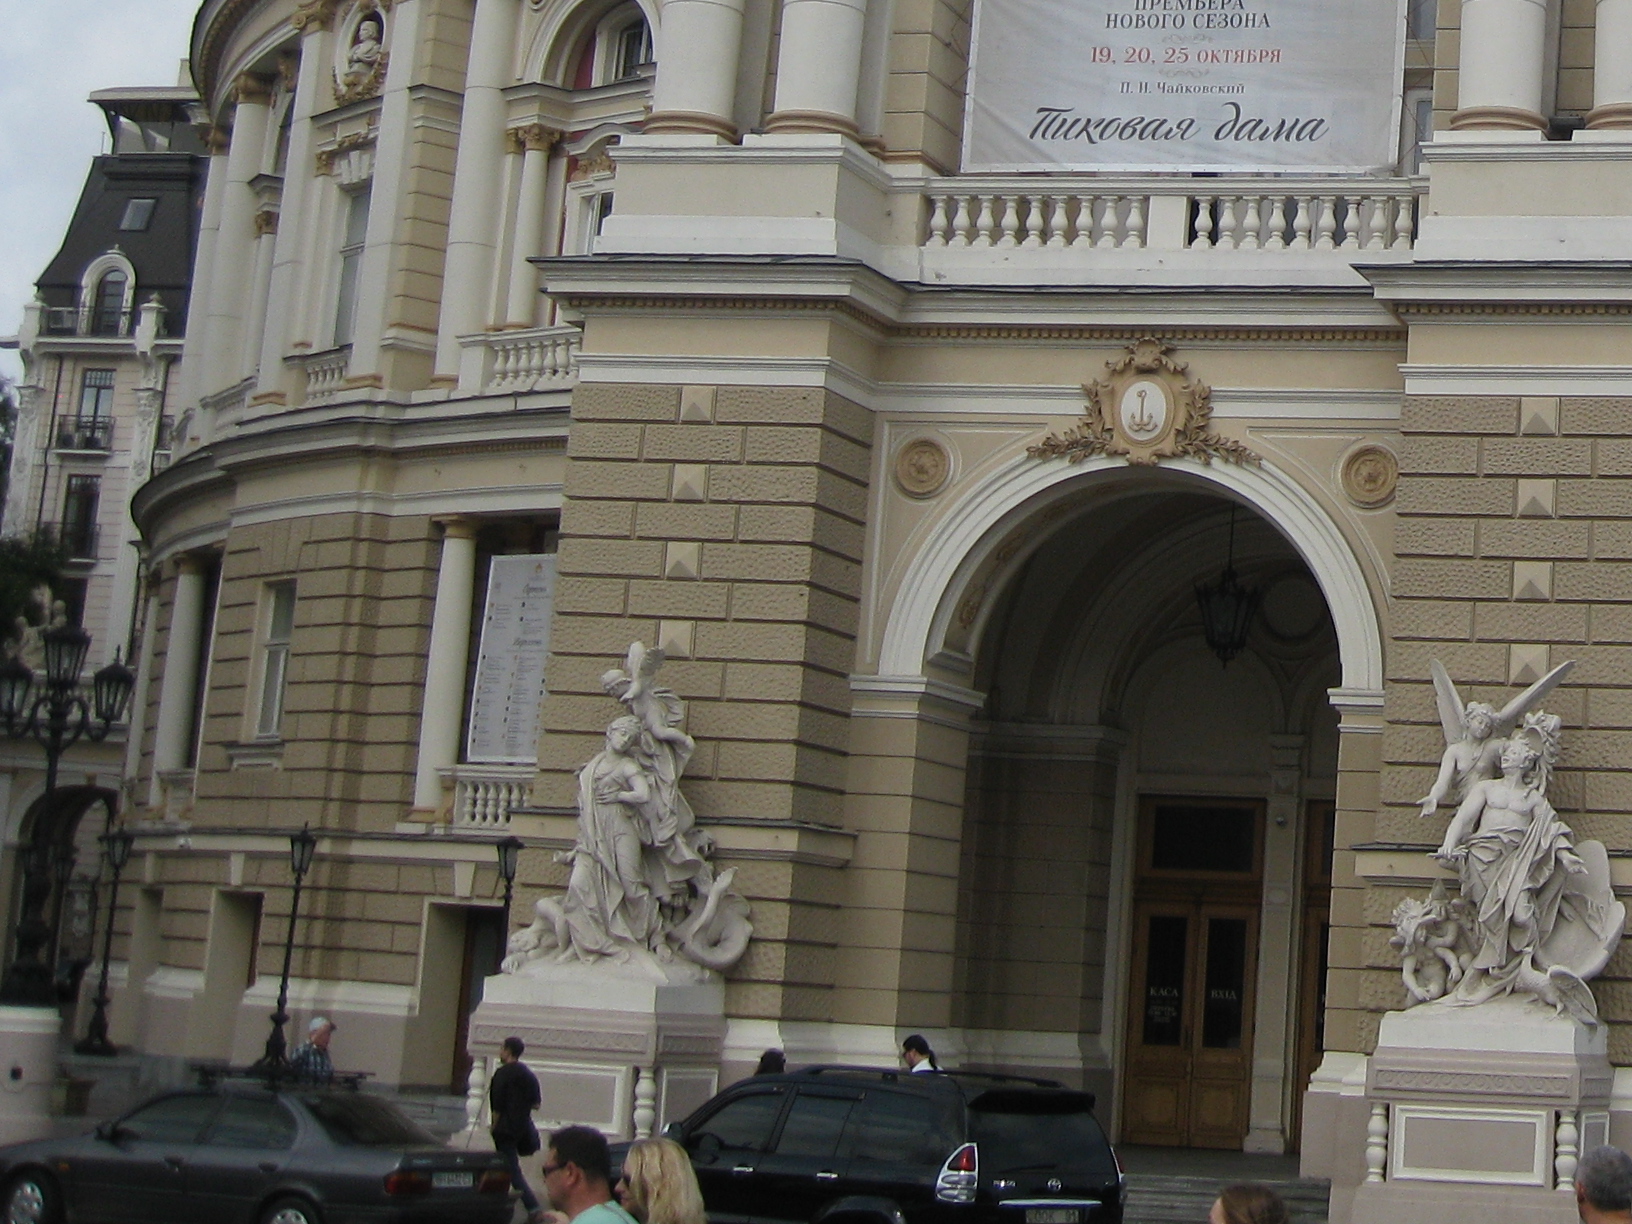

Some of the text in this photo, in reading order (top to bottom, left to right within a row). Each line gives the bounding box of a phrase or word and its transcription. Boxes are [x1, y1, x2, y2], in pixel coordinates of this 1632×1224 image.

[1105, 12, 1271, 29] НОВОГО СЕЗОНА
[1090, 46, 1282, 64] 19, 20, 25 ОКТЯБРЯ
[1119, 82, 1133, 94] П.
[1156, 81, 1245, 94] Чайковский
[1028, 101, 1330, 144] Пиковая дама
[1150, 986, 1179, 998] КАСА
